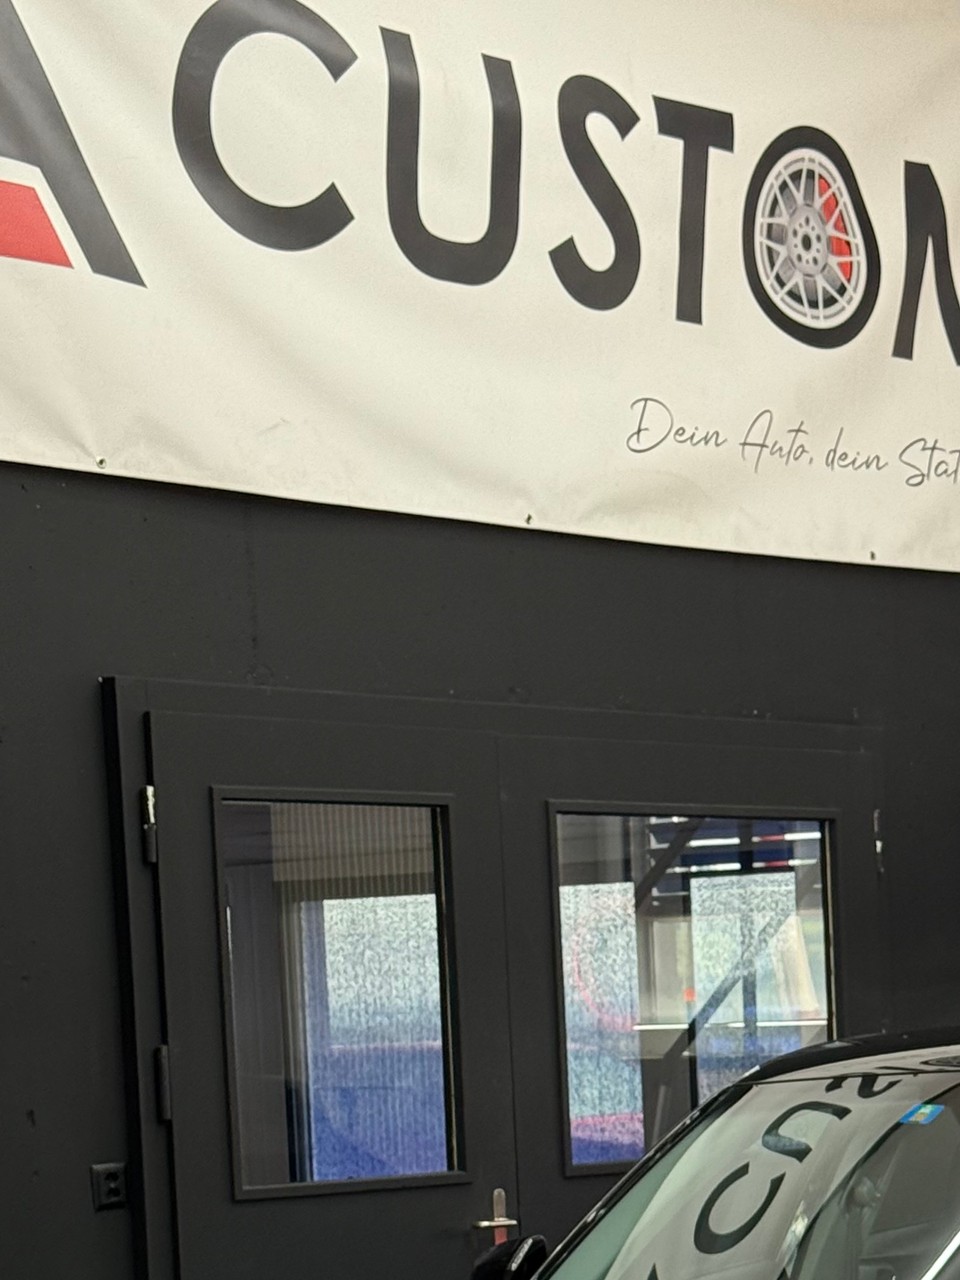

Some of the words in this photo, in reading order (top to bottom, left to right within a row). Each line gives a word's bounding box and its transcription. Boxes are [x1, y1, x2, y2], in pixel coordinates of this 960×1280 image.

[626, 397, 728, 454] Dein
[739, 409, 814, 474] Auto,
[825, 426, 889, 471] dein
